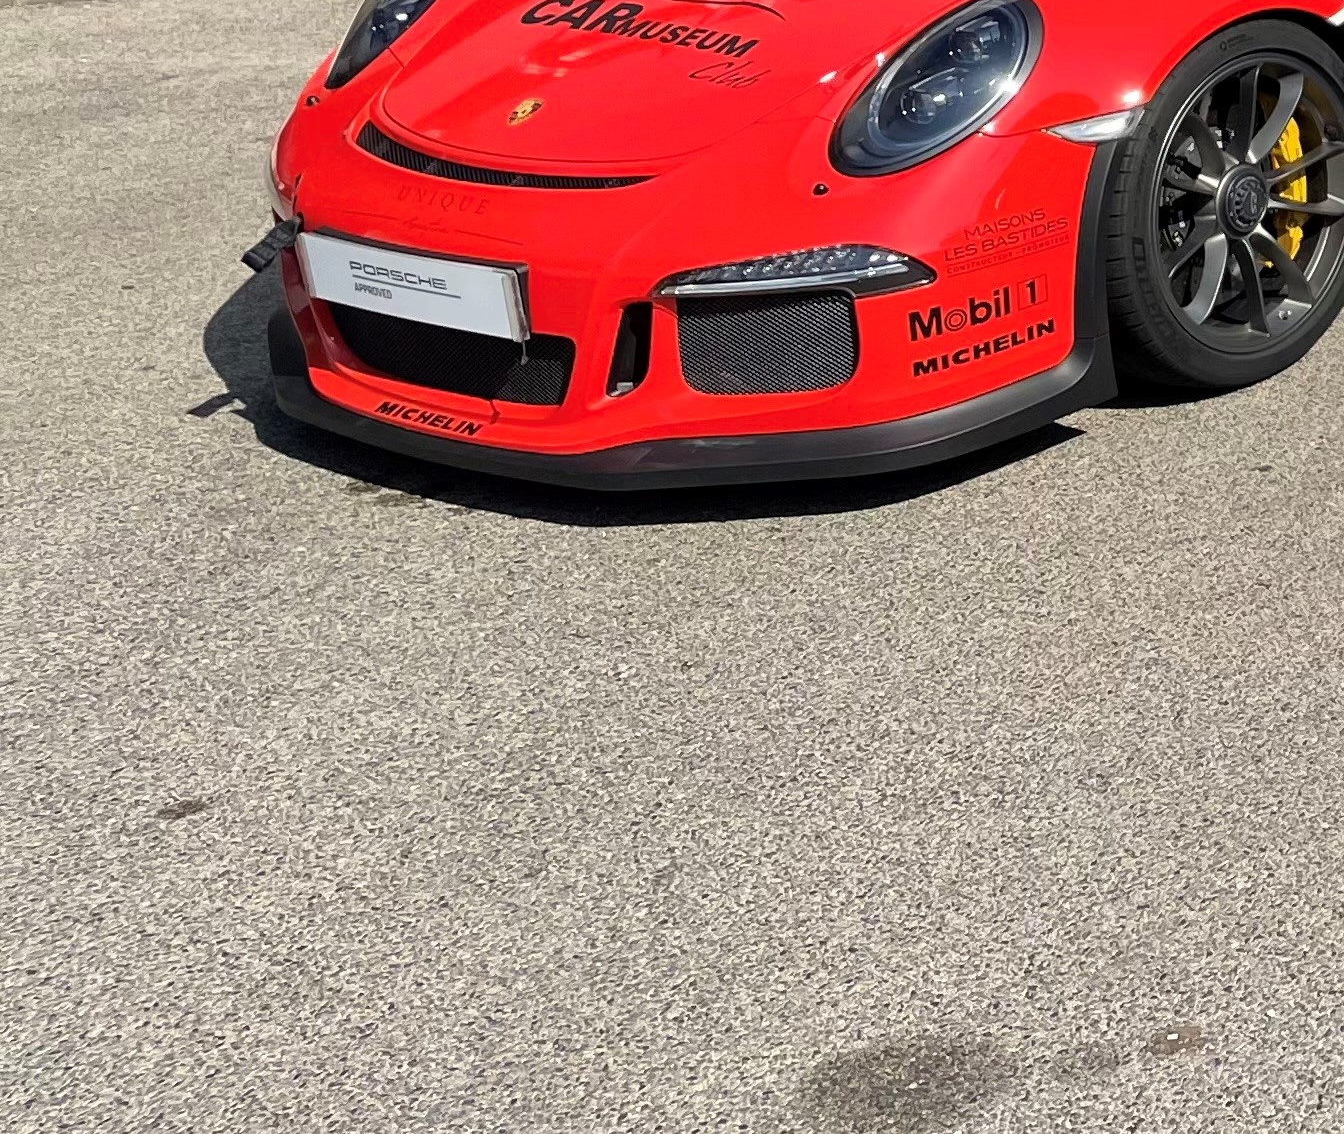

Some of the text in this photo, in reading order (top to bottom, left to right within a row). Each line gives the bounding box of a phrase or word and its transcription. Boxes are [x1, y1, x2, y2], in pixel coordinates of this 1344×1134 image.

[688, 61, 772, 89] Club
[397, 186, 491, 216] UNIQUE
[943, 216, 1069, 262] LES BASTIDES
[963, 207, 1047, 241] MAISONS
[349, 260, 448, 291] PORSCHE
[354, 282, 393, 300] APPROVED
[908, 278, 1036, 342] Mobil 1
[912, 318, 1056, 377] MICHELIN
[373, 401, 484, 436] MICHELIN
